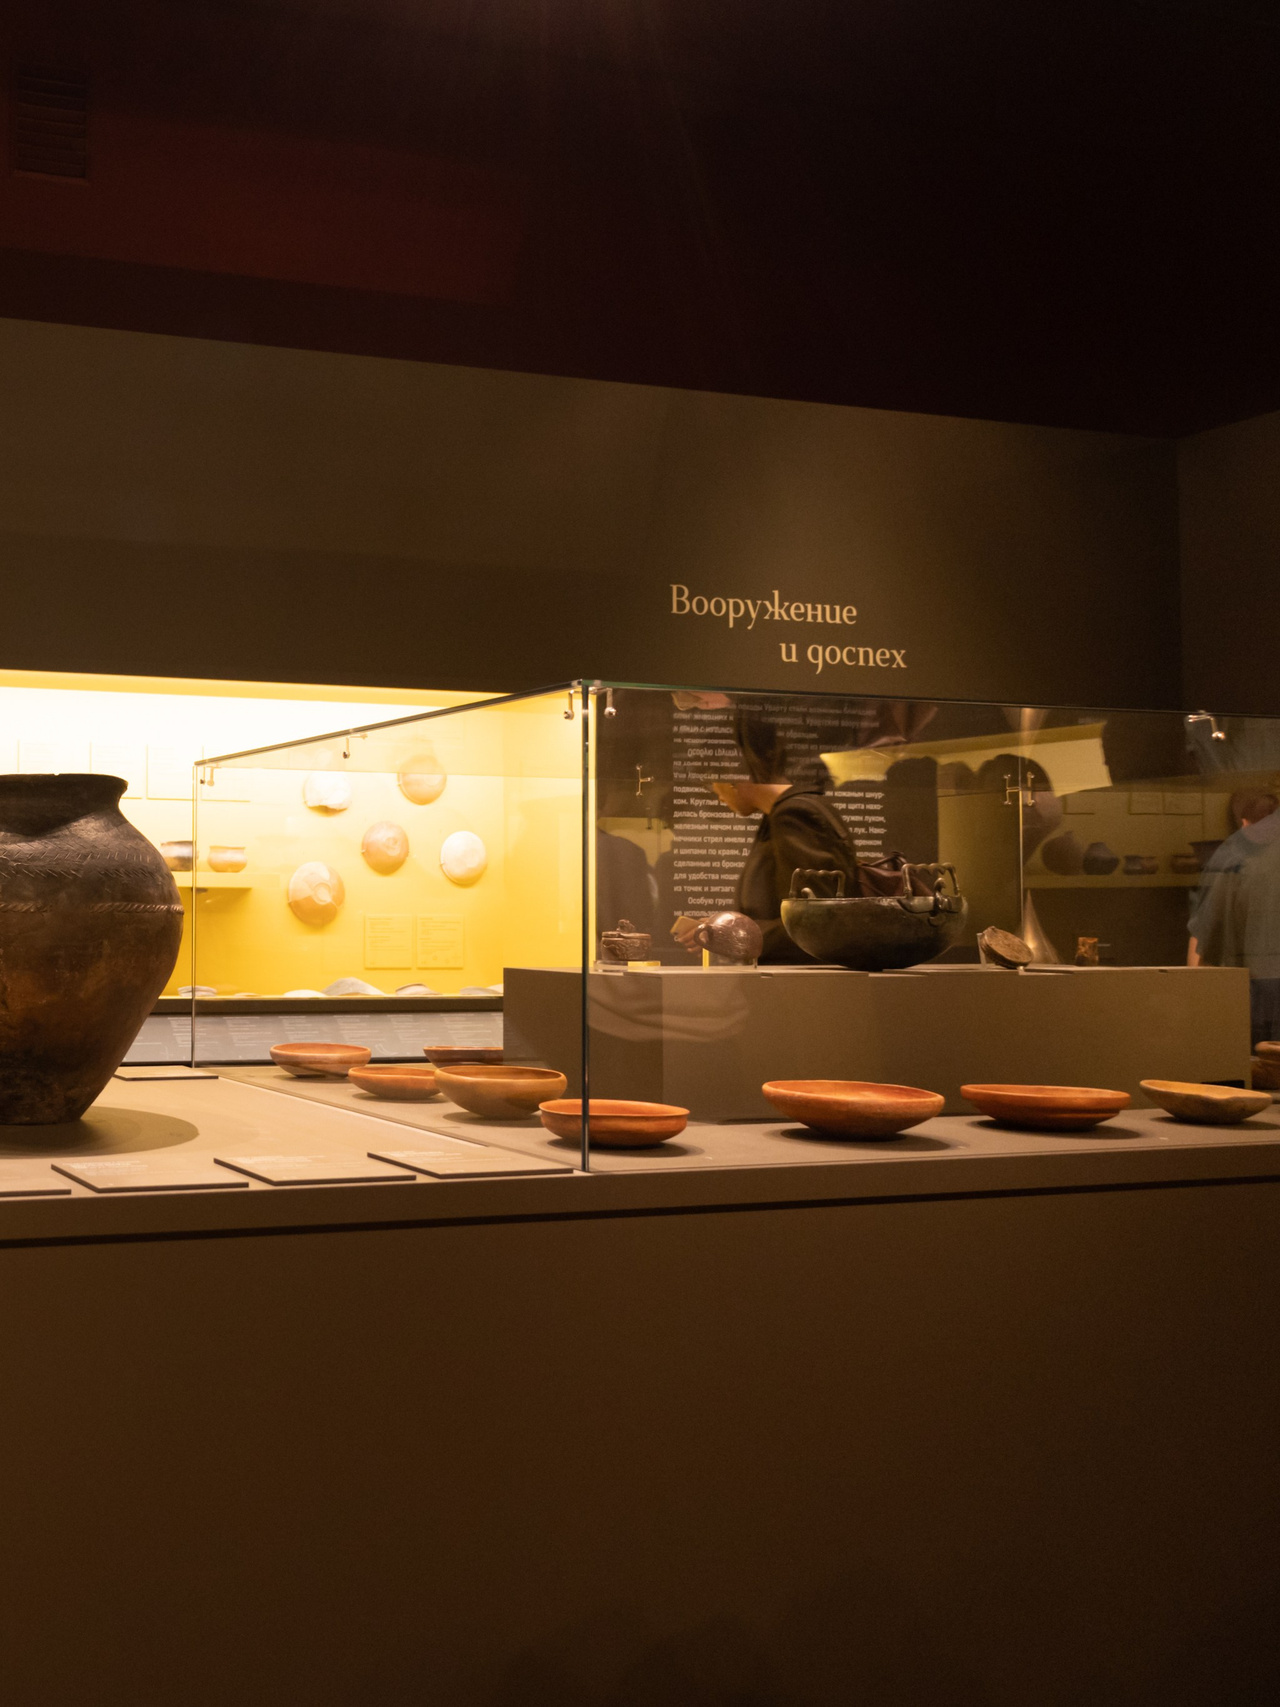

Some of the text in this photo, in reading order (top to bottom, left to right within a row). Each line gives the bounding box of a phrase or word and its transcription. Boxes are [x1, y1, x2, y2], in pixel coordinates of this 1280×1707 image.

[669, 583, 857, 630] Вооружение
[779, 642, 907, 674] и доспех
[690, 797, 719, 806] Круглые
[699, 810, 734, 819] бронзовая
[853, 827, 867, 835] лук.
[869, 826, 887, 834] Нако-
[703, 836, 723, 844] стрел
[688, 872, 719, 881] удобства
[687, 896, 714, 906] Особую
